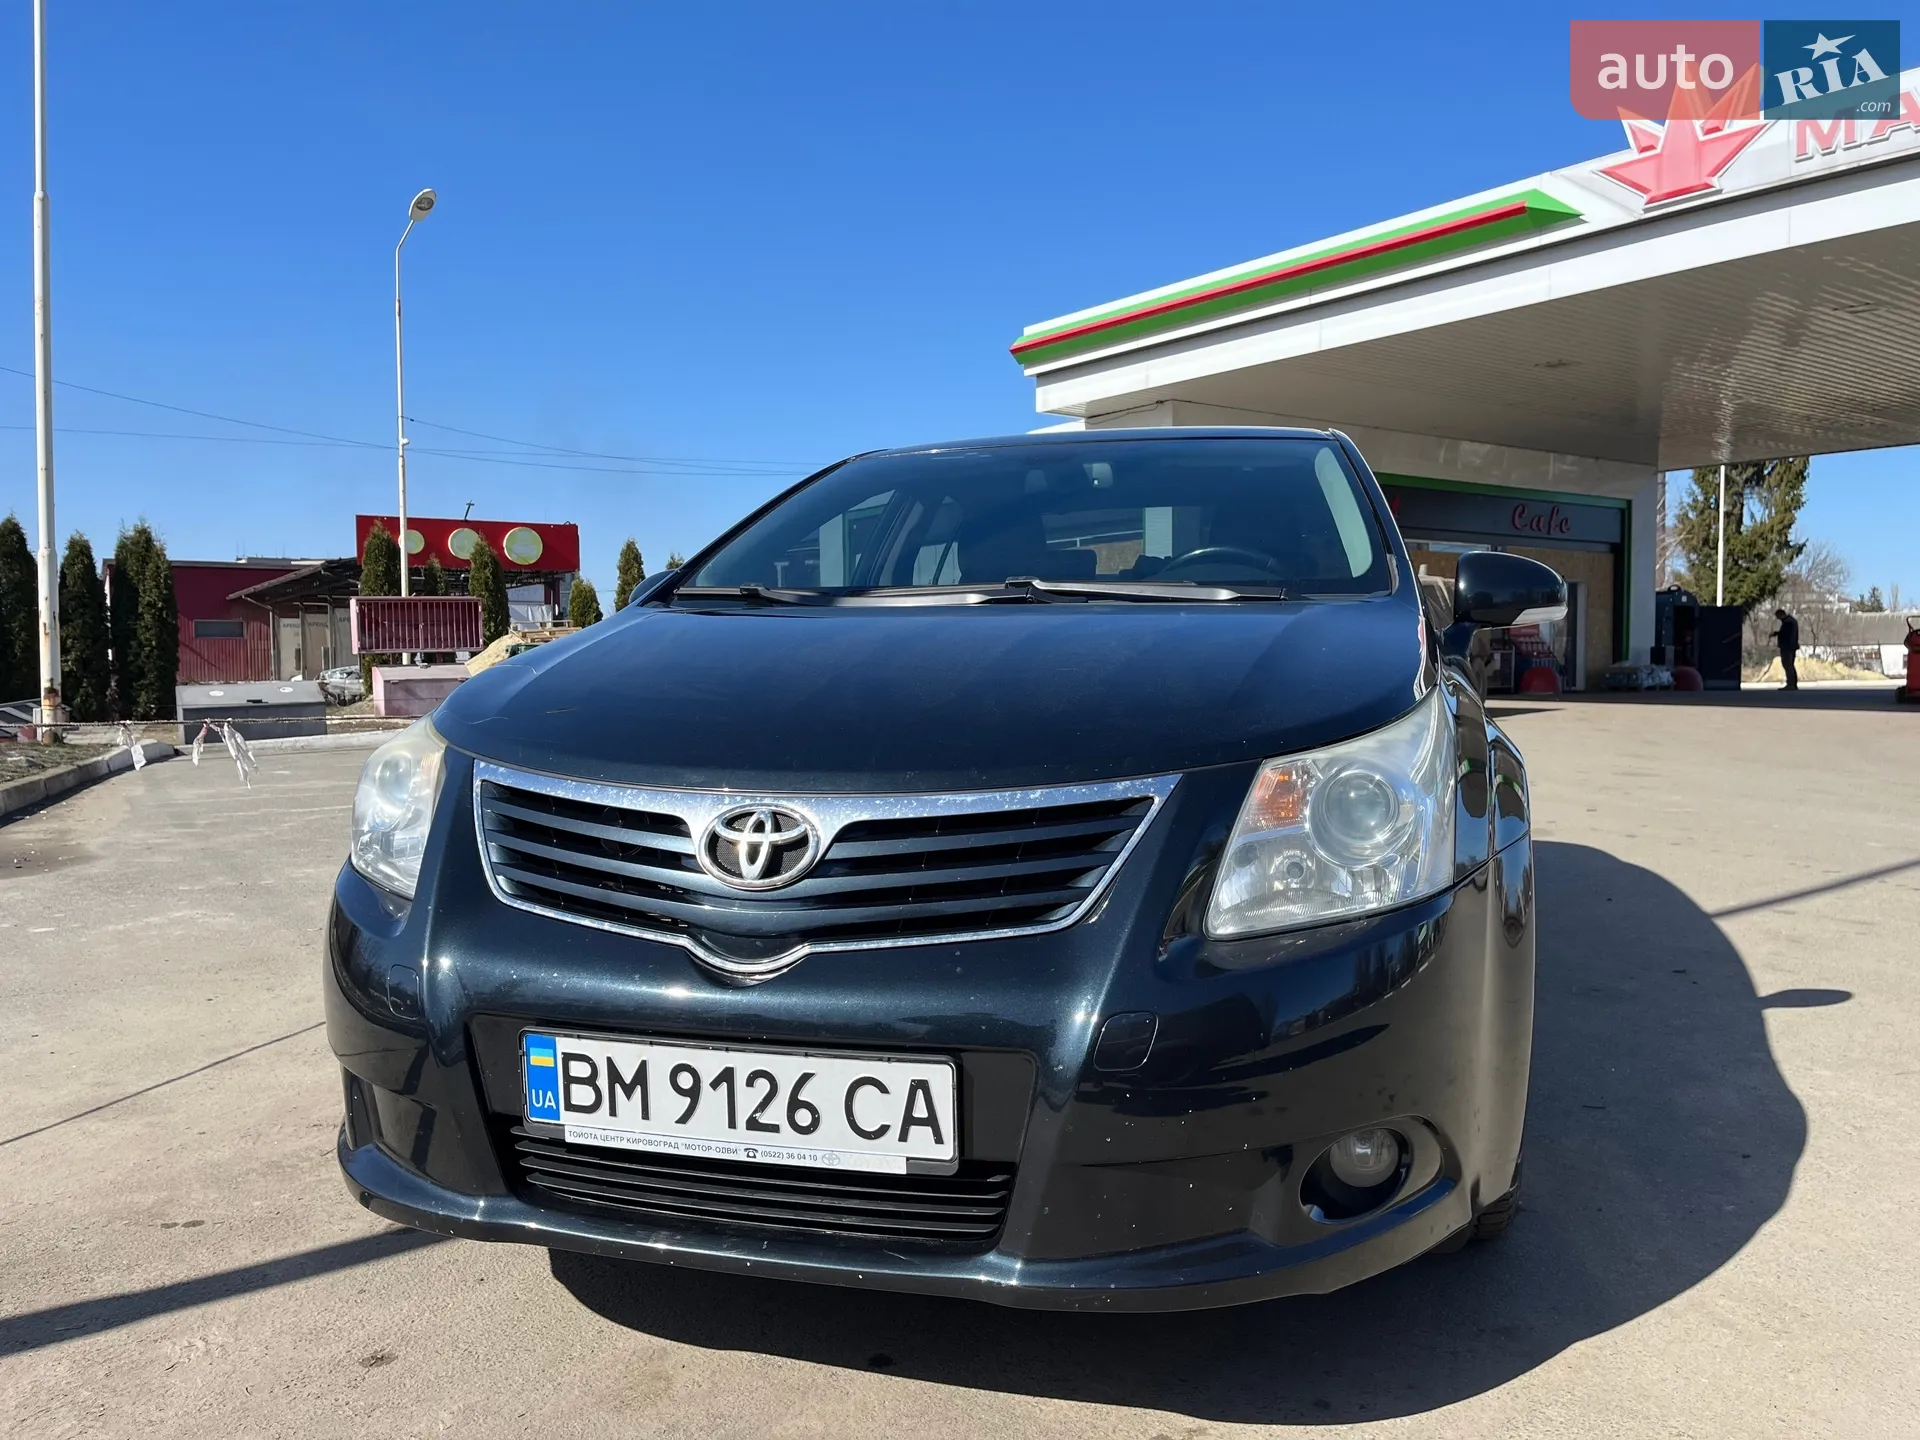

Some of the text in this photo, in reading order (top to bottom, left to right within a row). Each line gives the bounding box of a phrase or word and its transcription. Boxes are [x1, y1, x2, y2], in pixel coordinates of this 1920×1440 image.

[1511, 503, 1570, 535] Cafe
[531, 1088, 556, 1109] UA
[561, 1052, 944, 1145] BM 9126 CA
[568, 1130, 598, 1141] ТОЙОТА
[600, 1134, 625, 1143] ЦЕНТР
[626, 1137, 680, 1150] КИРОВОГРАД
[760, 1150, 784, 1160] (0522)
[786, 1152, 795, 1160] 36
[797, 1153, 806, 1161] 04
